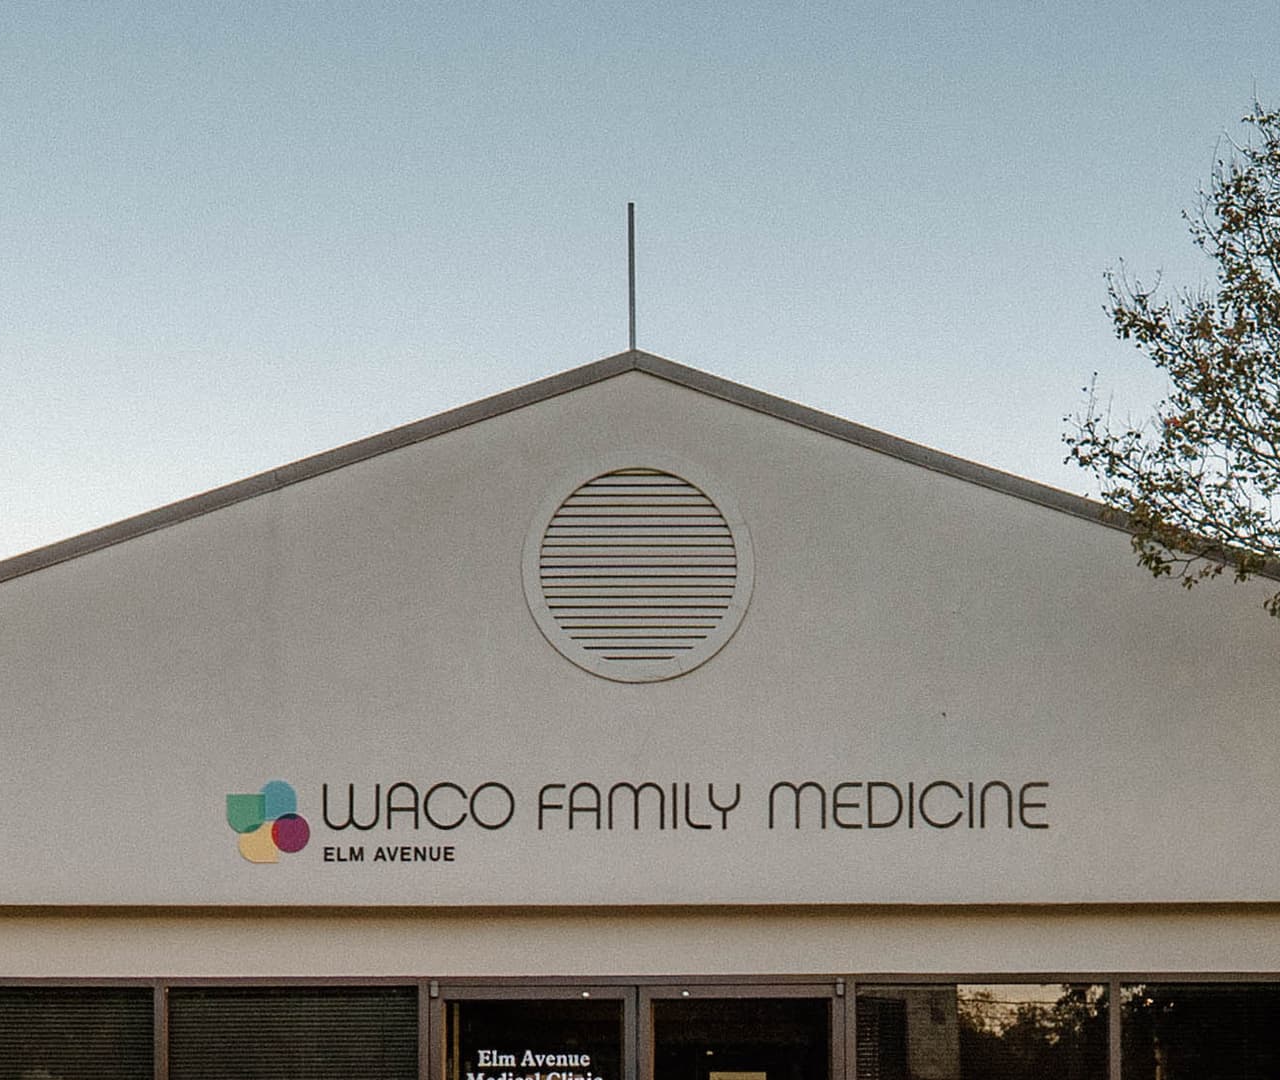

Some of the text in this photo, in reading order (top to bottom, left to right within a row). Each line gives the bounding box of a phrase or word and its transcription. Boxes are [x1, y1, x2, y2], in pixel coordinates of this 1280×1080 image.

[321, 780, 1052, 832] WACO FAMILY MEDICINE
[322, 846, 456, 863] ELM AVENUE
[477, 1049, 591, 1067] Elm Avenue
